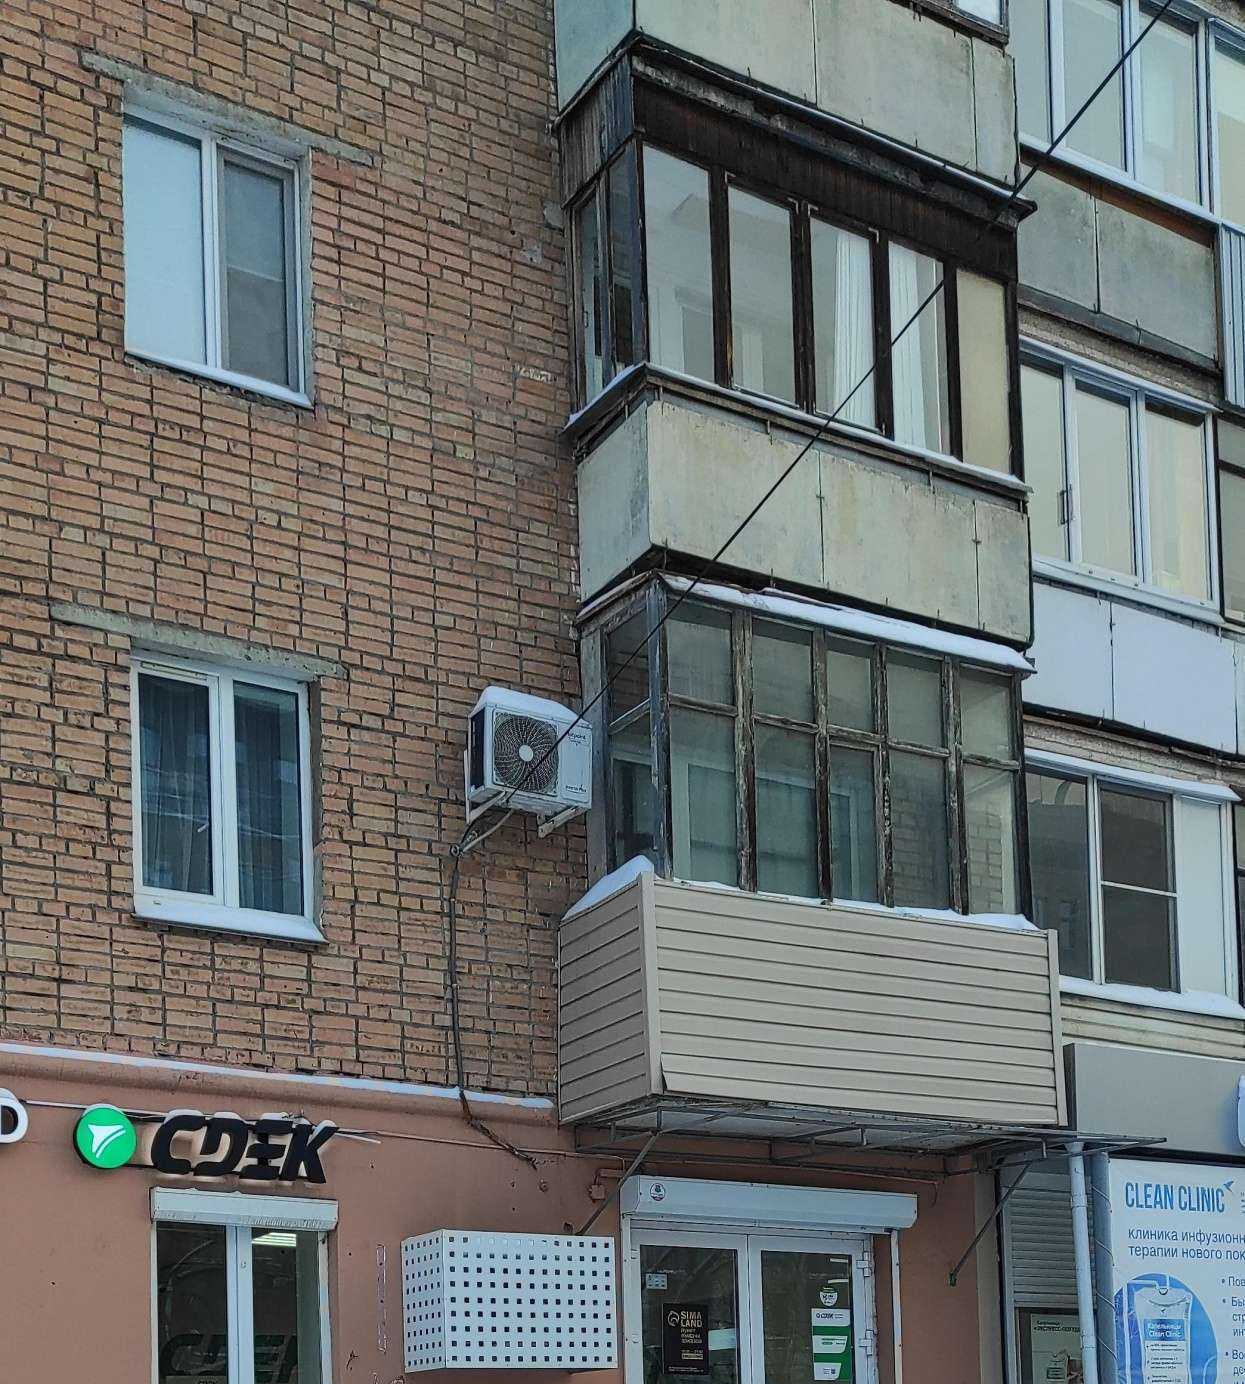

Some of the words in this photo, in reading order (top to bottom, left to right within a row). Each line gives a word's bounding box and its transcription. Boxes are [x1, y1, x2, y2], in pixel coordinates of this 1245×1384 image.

[151, 1113, 339, 1184] CDEK
[1125, 1182, 1174, 1210] CLEAN
[1178, 1185, 1225, 1213] CLINIC
[1128, 1229, 1178, 1241] клиника
[1128, 1246, 1178, 1260] терапии
[1182, 1248, 1222, 1260] нового
[680, 1311, 702, 1320] SIMA
[680, 1320, 703, 1328] LAND
